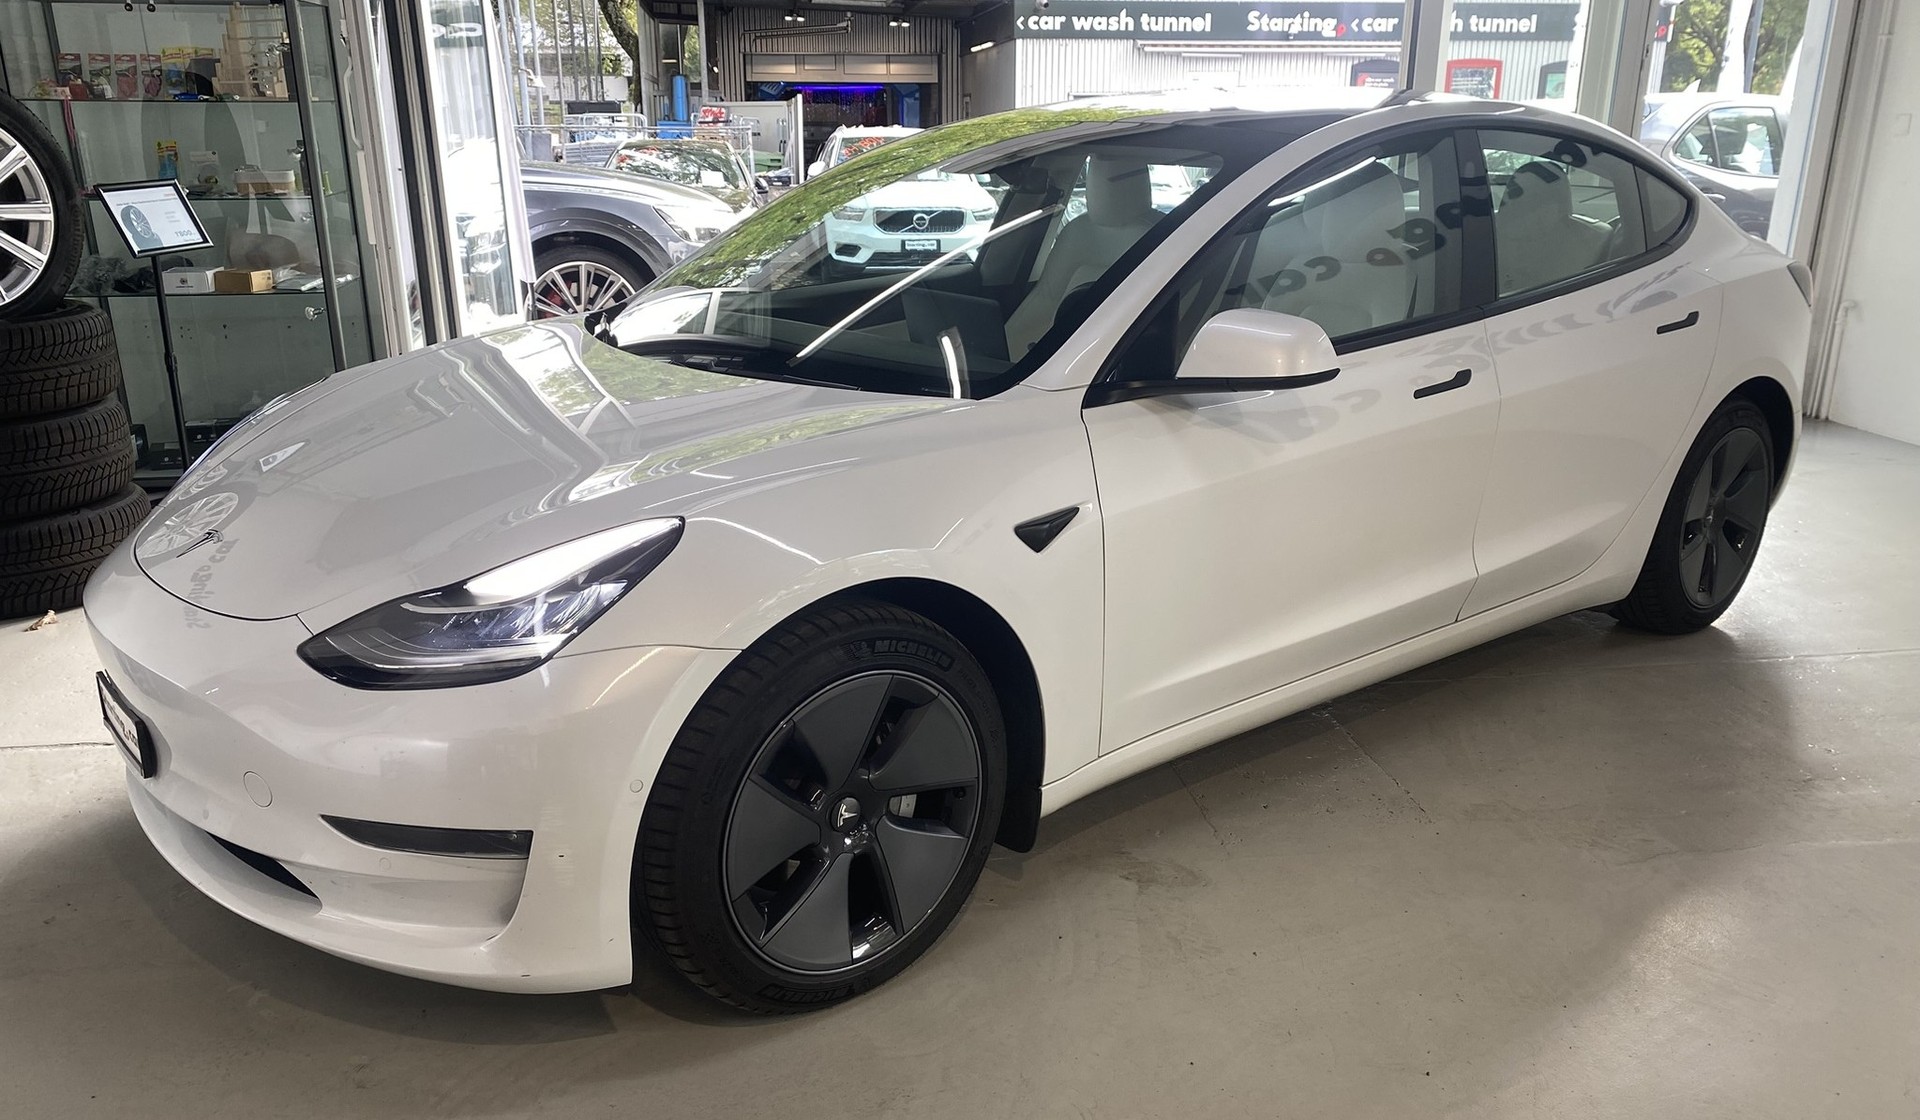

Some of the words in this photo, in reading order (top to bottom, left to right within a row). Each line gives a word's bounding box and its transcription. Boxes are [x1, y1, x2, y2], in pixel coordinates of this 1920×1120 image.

[1027, 15, 1066, 32] car
[1071, 8, 1135, 32] wash
[1140, 12, 1212, 32] tunnel
[1246, 10, 1338, 37] Starting
[1361, 15, 1399, 32] car
[1469, 13, 1538, 33] tunnel
[874, 639, 953, 668] MICHELIN
